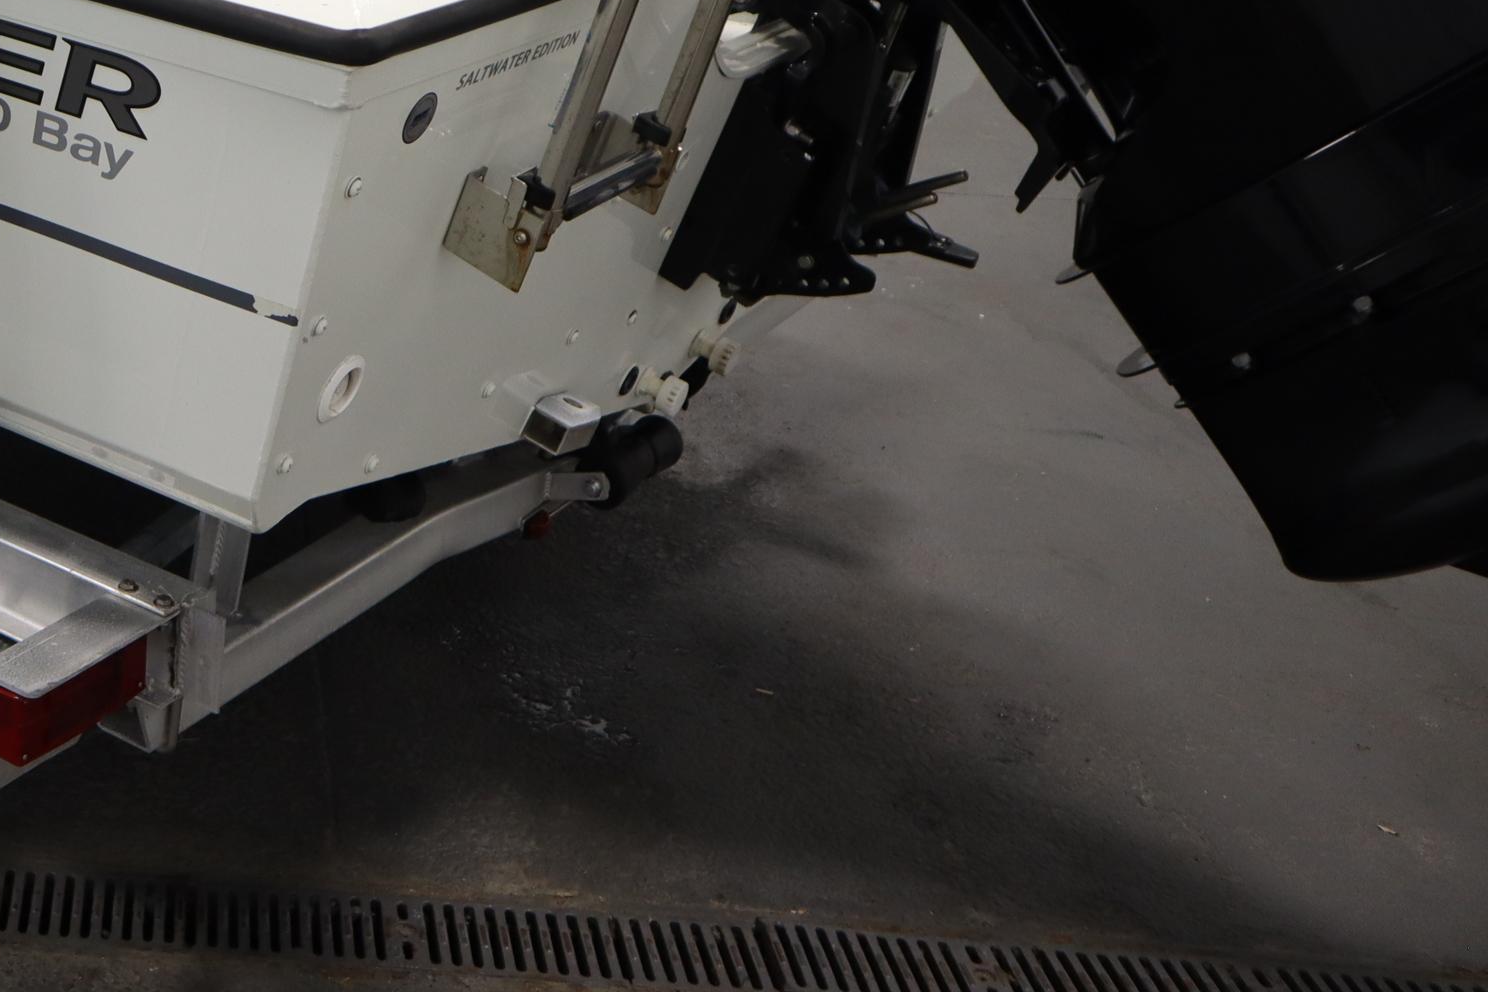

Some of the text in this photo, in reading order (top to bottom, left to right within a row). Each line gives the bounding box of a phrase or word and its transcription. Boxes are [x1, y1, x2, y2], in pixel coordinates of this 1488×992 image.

[455, 29, 581, 91] SALTWATER EDITION
[32, 110, 134, 180] Bay
